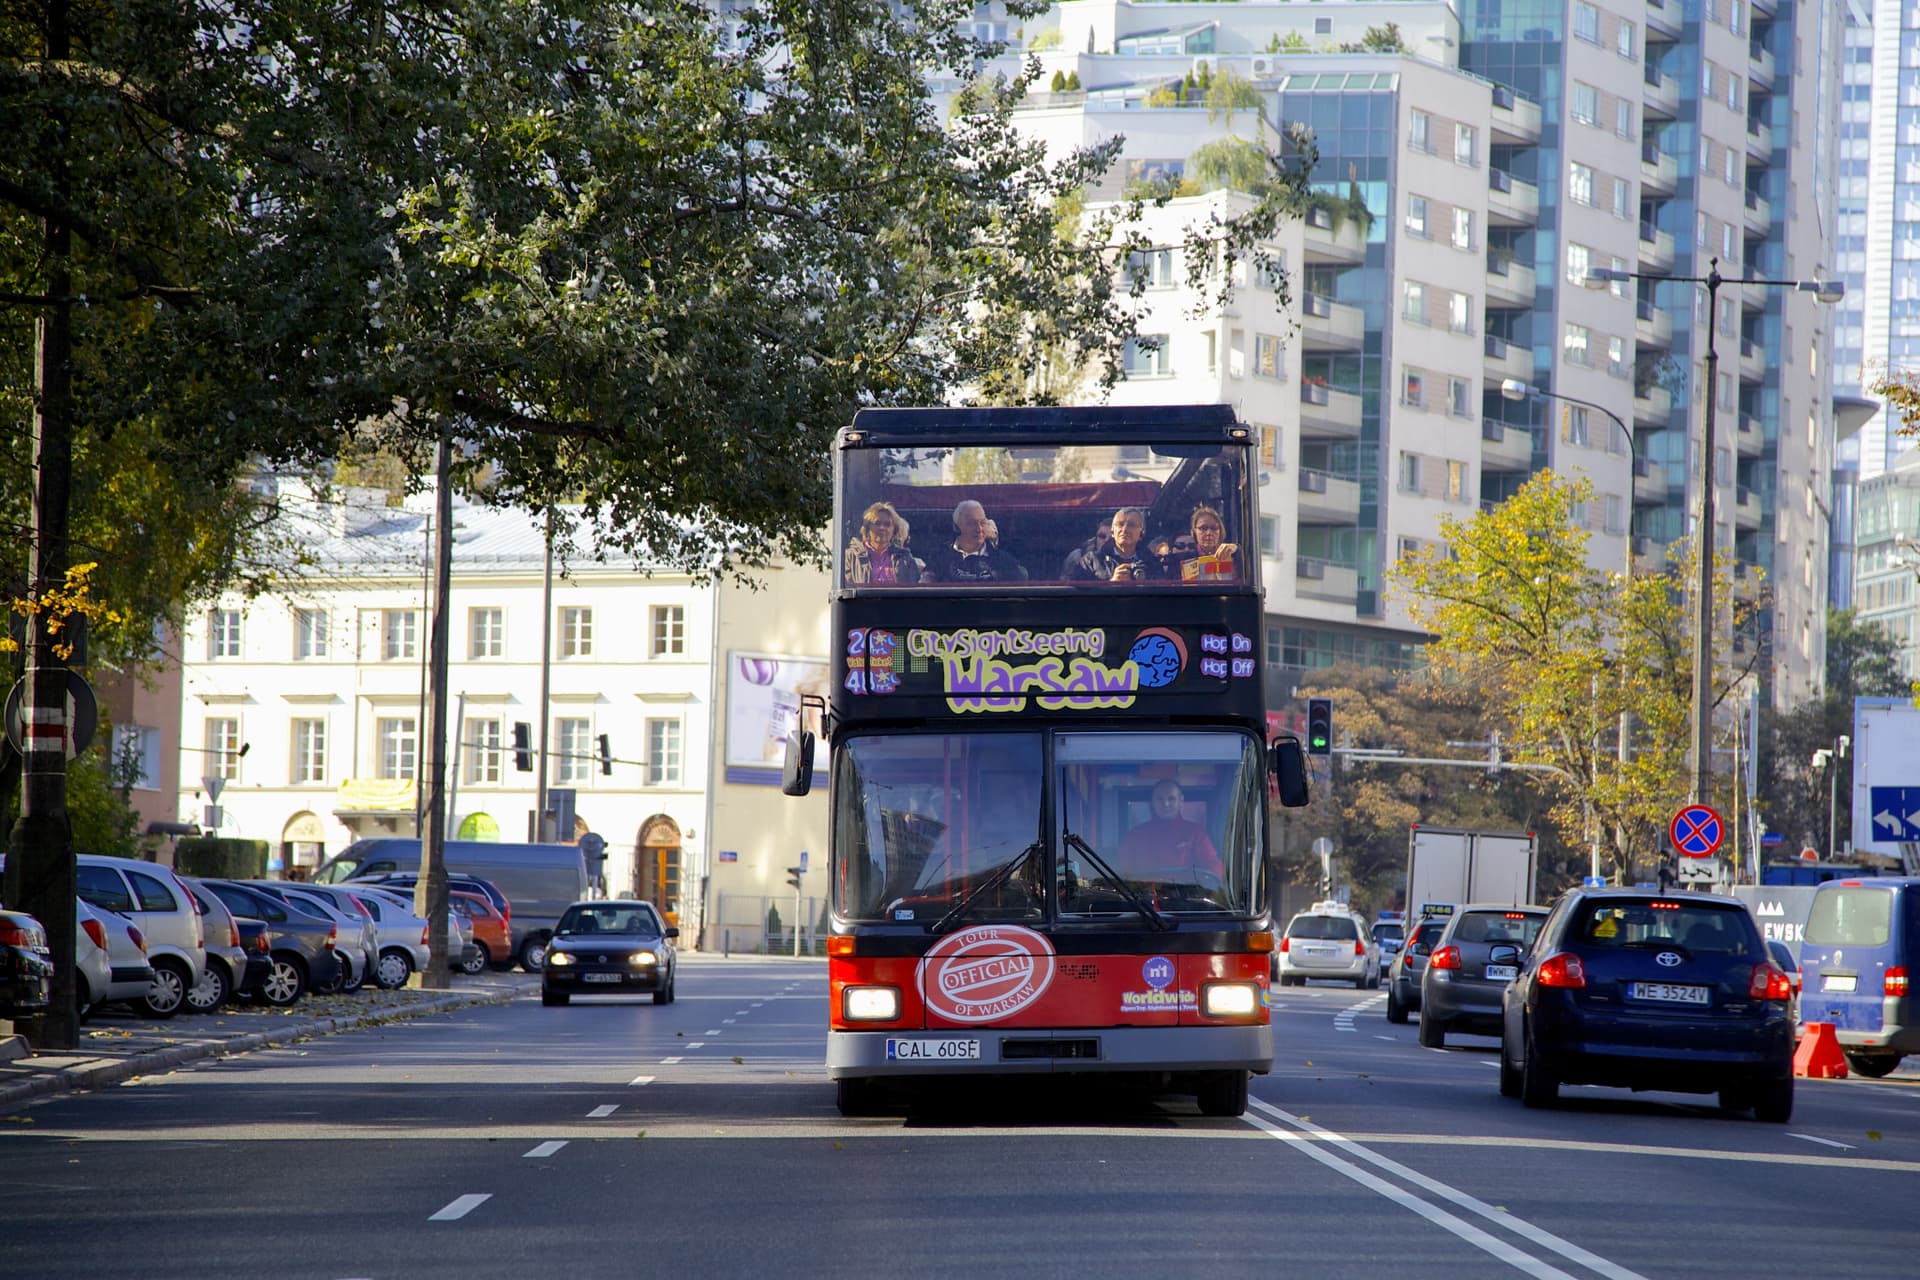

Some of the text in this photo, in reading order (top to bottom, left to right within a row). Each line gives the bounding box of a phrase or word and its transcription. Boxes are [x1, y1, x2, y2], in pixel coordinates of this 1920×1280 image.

[1203, 635, 1250, 651] Hop On
[1203, 660, 1252, 675] Hop Off
[956, 930, 998, 947] TOUR
[944, 956, 1031, 989] OFFICIAL
[955, 982, 1035, 1016] OF WARSAW
[1636, 983, 1706, 1001] WE 3524V
[897, 1041, 932, 1057] CAL
[937, 1041, 978, 1057] 60SF
